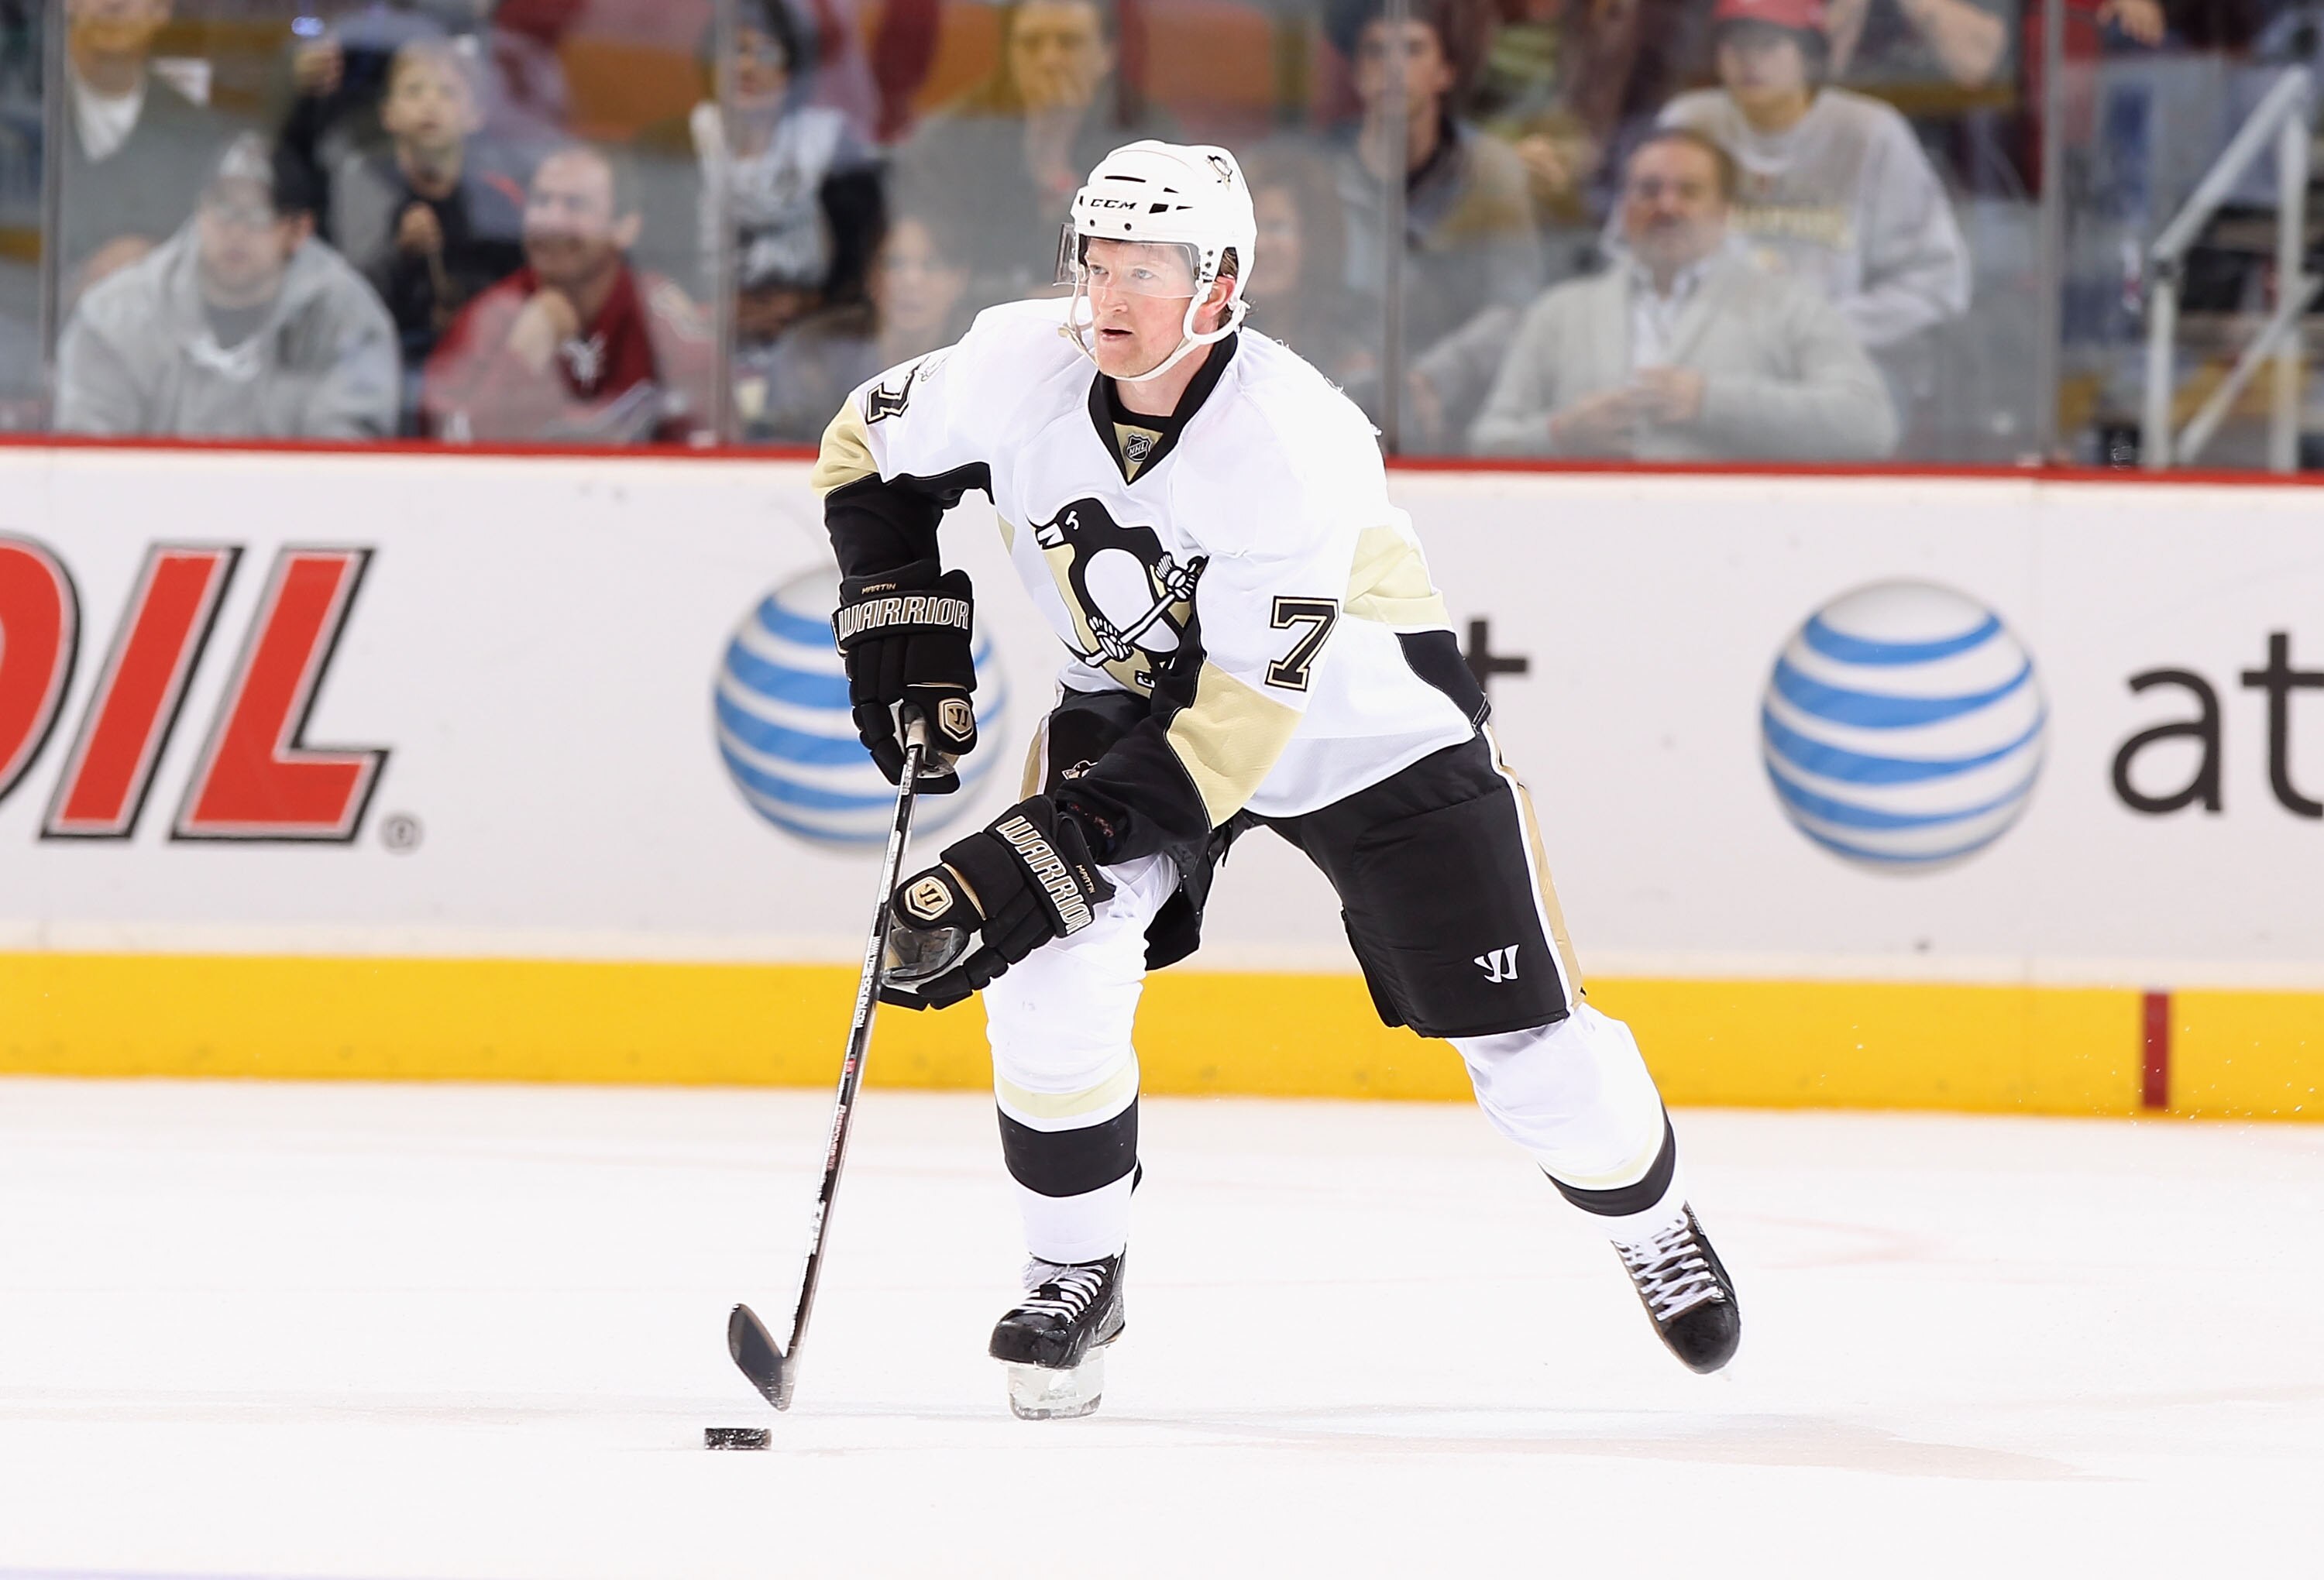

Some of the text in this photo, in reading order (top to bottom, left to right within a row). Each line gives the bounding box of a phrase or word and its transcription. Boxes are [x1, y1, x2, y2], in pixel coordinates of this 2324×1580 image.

[1090, 198, 1137, 210] CCM
[1128, 443, 1146, 456] NHL
[861, 583, 897, 595] MARTIN
[838, 596, 969, 642] WARRIOR
[1264, 596, 1339, 692] 7
[995, 816, 1092, 935] WARRIOR
